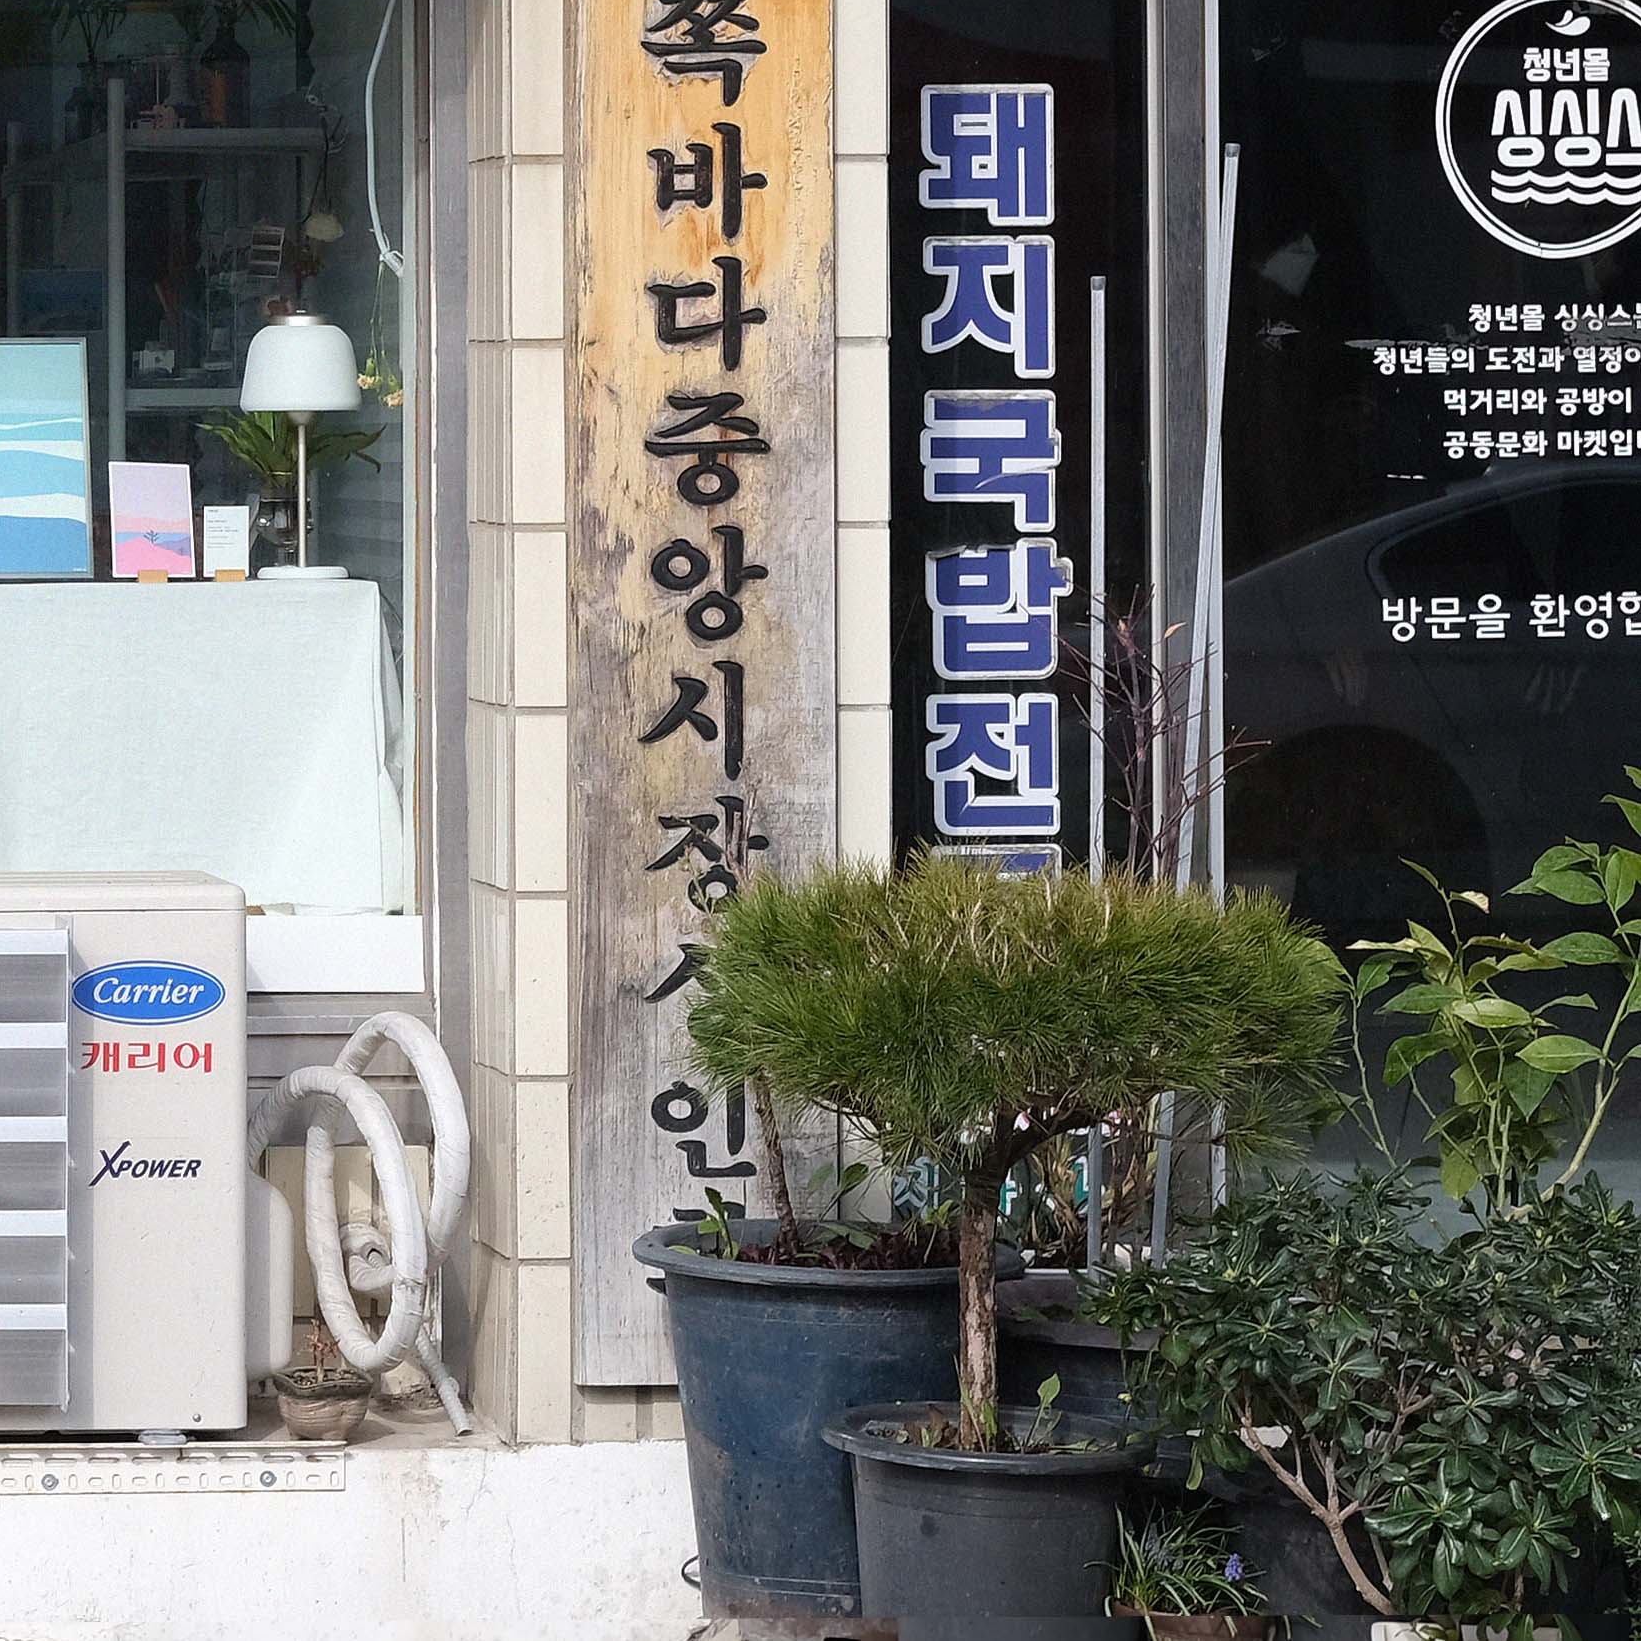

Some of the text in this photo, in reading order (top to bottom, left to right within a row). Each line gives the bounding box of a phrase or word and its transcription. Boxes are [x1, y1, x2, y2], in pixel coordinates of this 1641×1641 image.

[1523, 47, 1610, 82] 청년몰
[1491, 87, 1641, 167] 싱싱스
[1468, 303, 1641, 333] 청년몰 싱싱스
[1373, 345, 1475, 376] 청년들의
[1485, 345, 1565, 374] 도전과
[1443, 387, 1632, 416] 먹거리와 공방이
[1443, 429, 1641, 459] 공동문화 마켓입
[918, 83, 1074, 880] 돼지국밥전
[1382, 593, 1511, 643] 방문을
[93, 977, 205, 1005] Carrier
[80, 1042, 214, 1073] 캐리어
[88, 1140, 202, 1187] XPOWER
